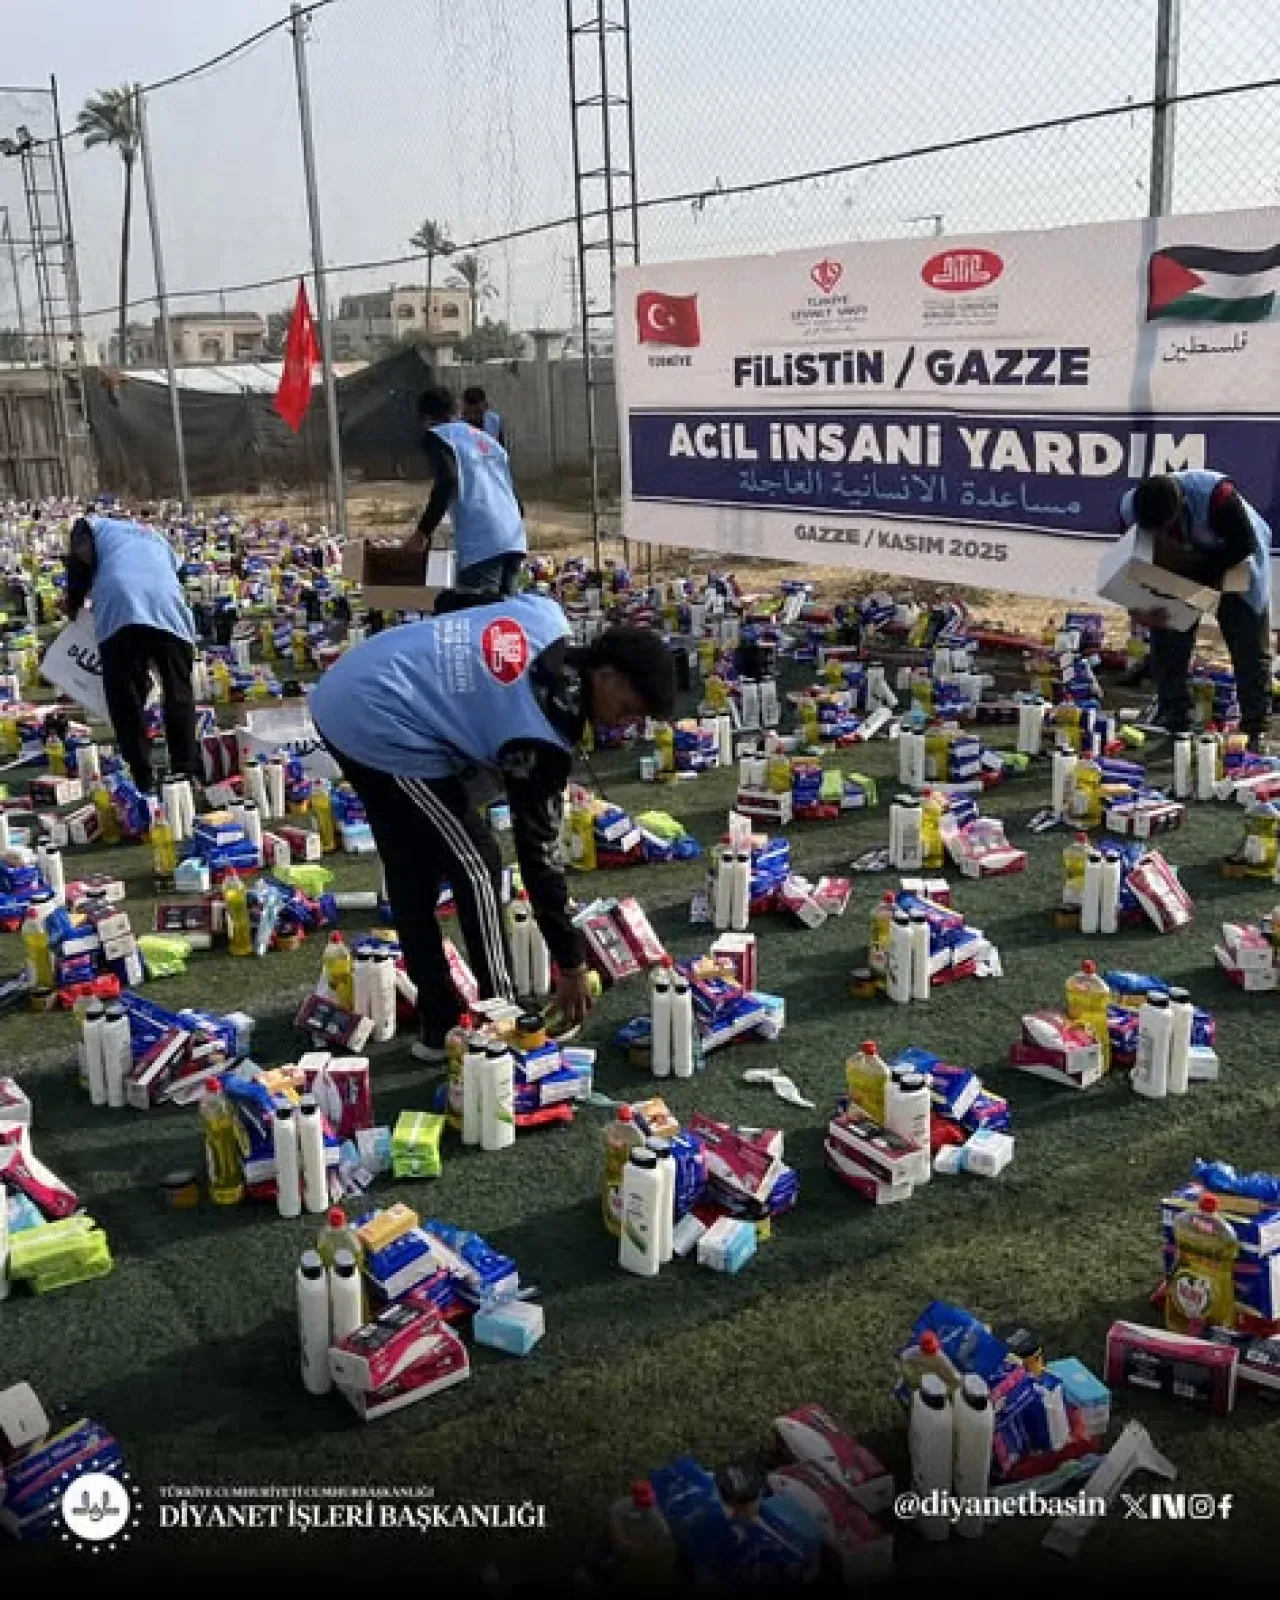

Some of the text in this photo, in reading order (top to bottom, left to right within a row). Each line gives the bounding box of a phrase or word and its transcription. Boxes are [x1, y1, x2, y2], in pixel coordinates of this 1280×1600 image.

[1163, 331, 1248, 364] فلسطين
[734, 346, 1090, 388] FİLİSTİN / GAZZE
[669, 423, 1205, 478] ACİL İNSANİ YARDIM
[739, 467, 822, 497] العاجلة
[960, 480, 1082, 514] مساعدة
[794, 523, 860, 546] GAZZE
[878, 530, 944, 556] KASIM
[949, 538, 1009, 562] 2025
